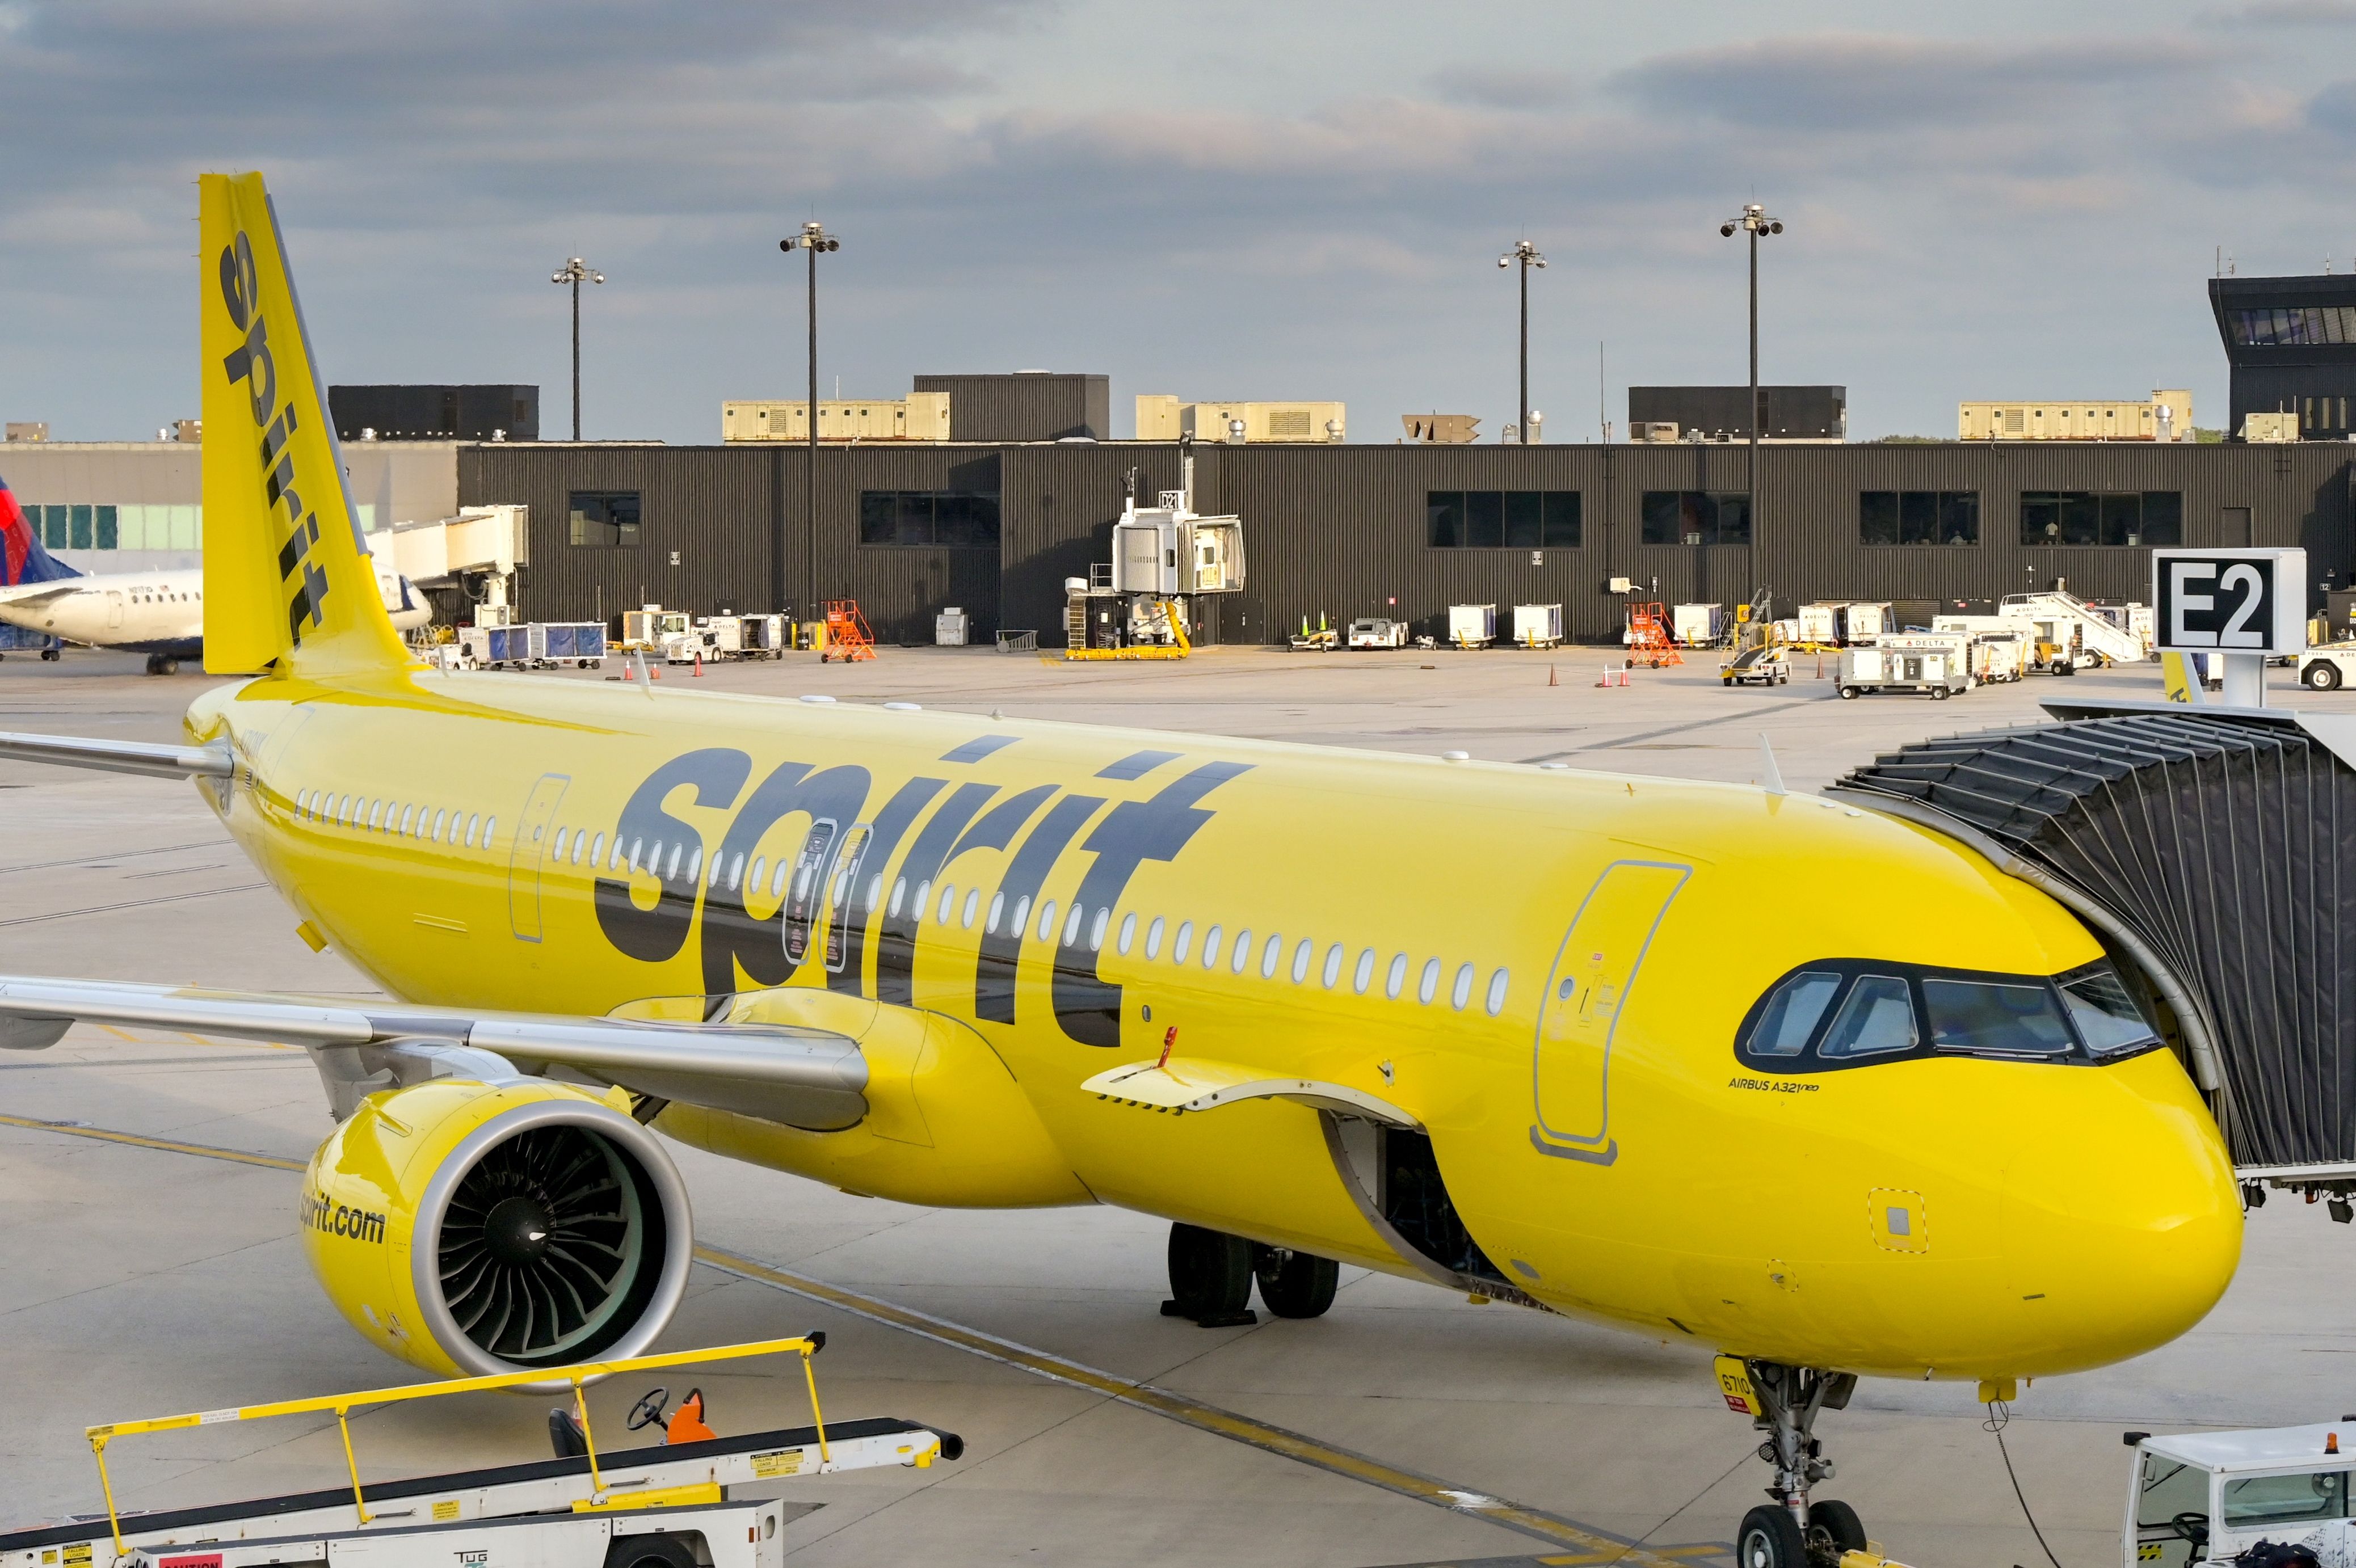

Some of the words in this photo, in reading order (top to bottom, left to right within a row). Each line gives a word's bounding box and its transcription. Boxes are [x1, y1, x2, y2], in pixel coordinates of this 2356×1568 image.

[220, 230, 329, 652] spirit
[1162, 493, 1177, 508] D21
[2171, 562, 2262, 647] E2
[594, 735, 1258, 1048] spirit
[1728, 1078, 1770, 1091] AIRBUS
[1771, 1082, 1819, 1093] A321neo
[300, 1189, 386, 1244] spirit.com
[1722, 1374, 1750, 1394] 6710
[453, 1550, 488, 1563] TUG
